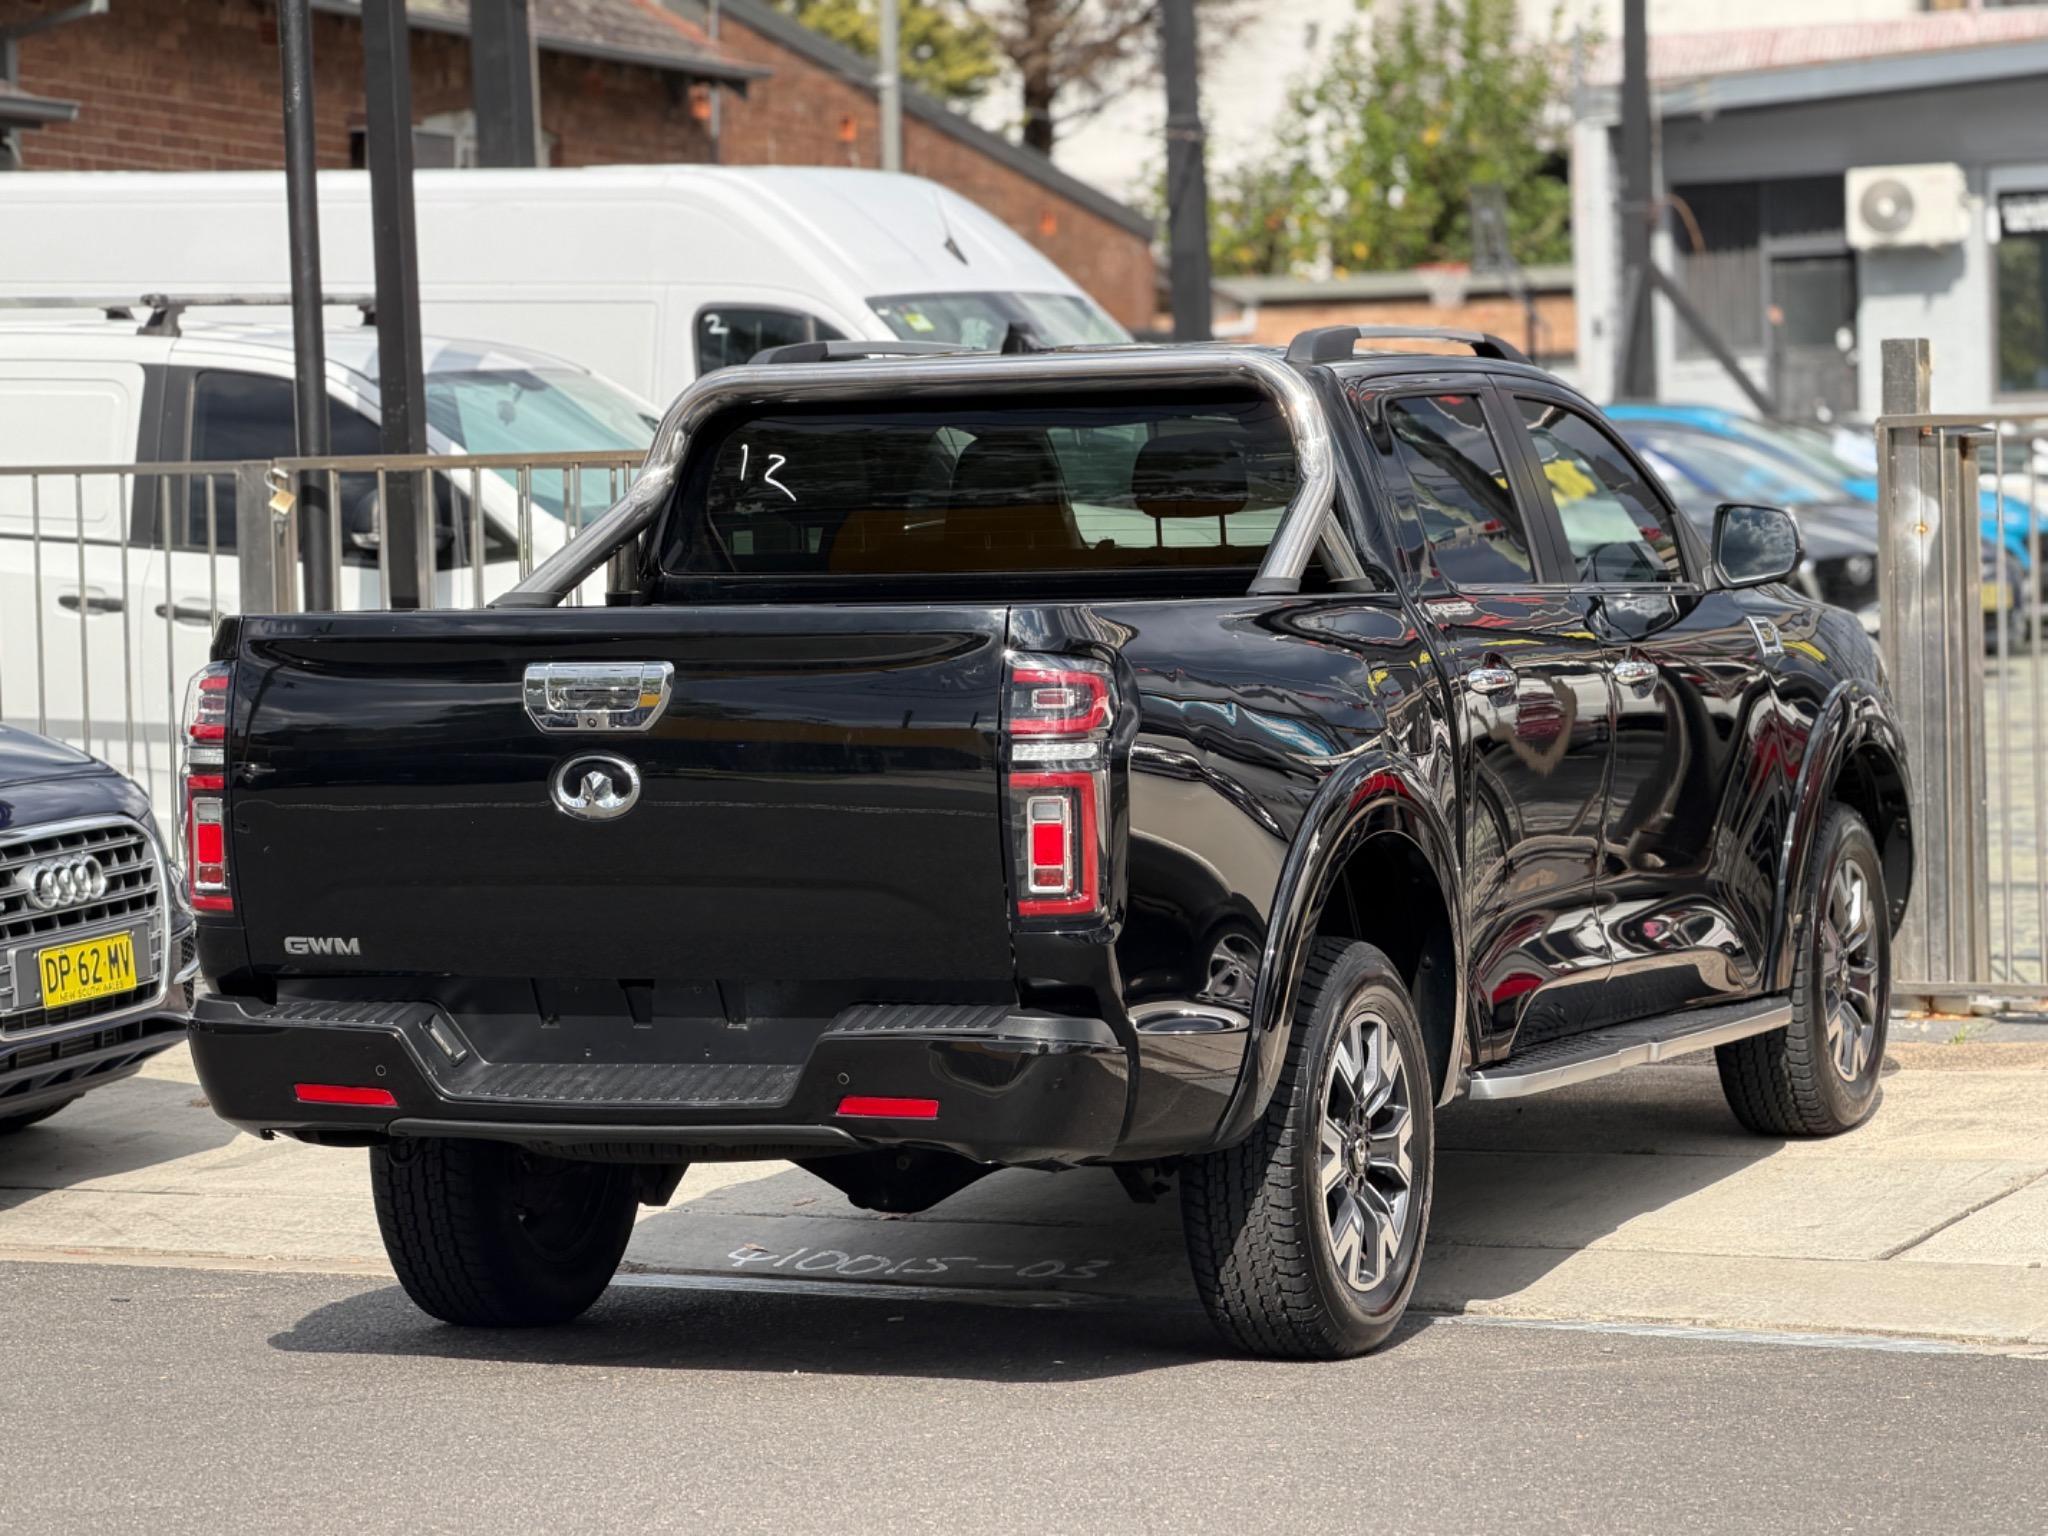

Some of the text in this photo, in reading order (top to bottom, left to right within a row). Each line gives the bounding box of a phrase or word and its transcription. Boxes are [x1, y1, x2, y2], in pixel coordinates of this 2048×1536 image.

[704, 313, 729, 334] 2
[284, 936, 361, 955] GWM
[45, 955, 71, 994] DP
[78, 947, 102, 986] 62
